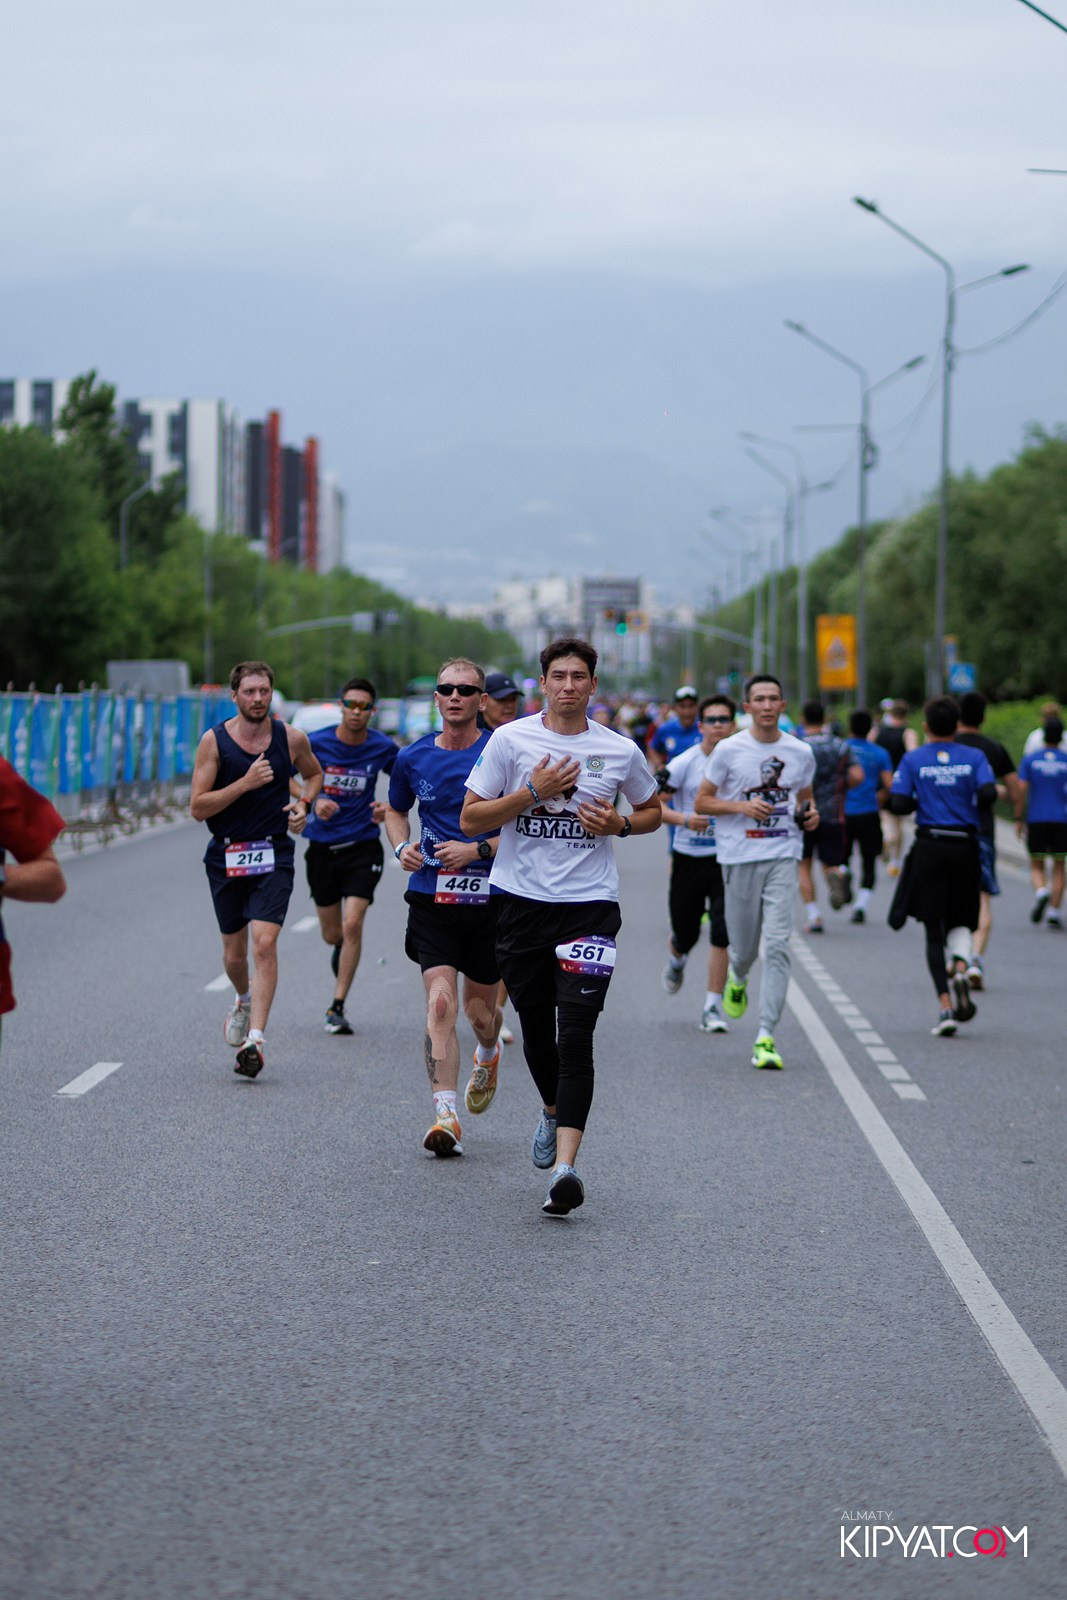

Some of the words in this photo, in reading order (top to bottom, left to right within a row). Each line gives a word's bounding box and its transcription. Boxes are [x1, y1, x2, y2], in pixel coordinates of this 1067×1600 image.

[331, 776, 359, 788] 248
[566, 841, 596, 850] TEAM
[236, 851, 264, 866] 214
[445, 877, 481, 892] 446
[568, 943, 605, 962] 561
